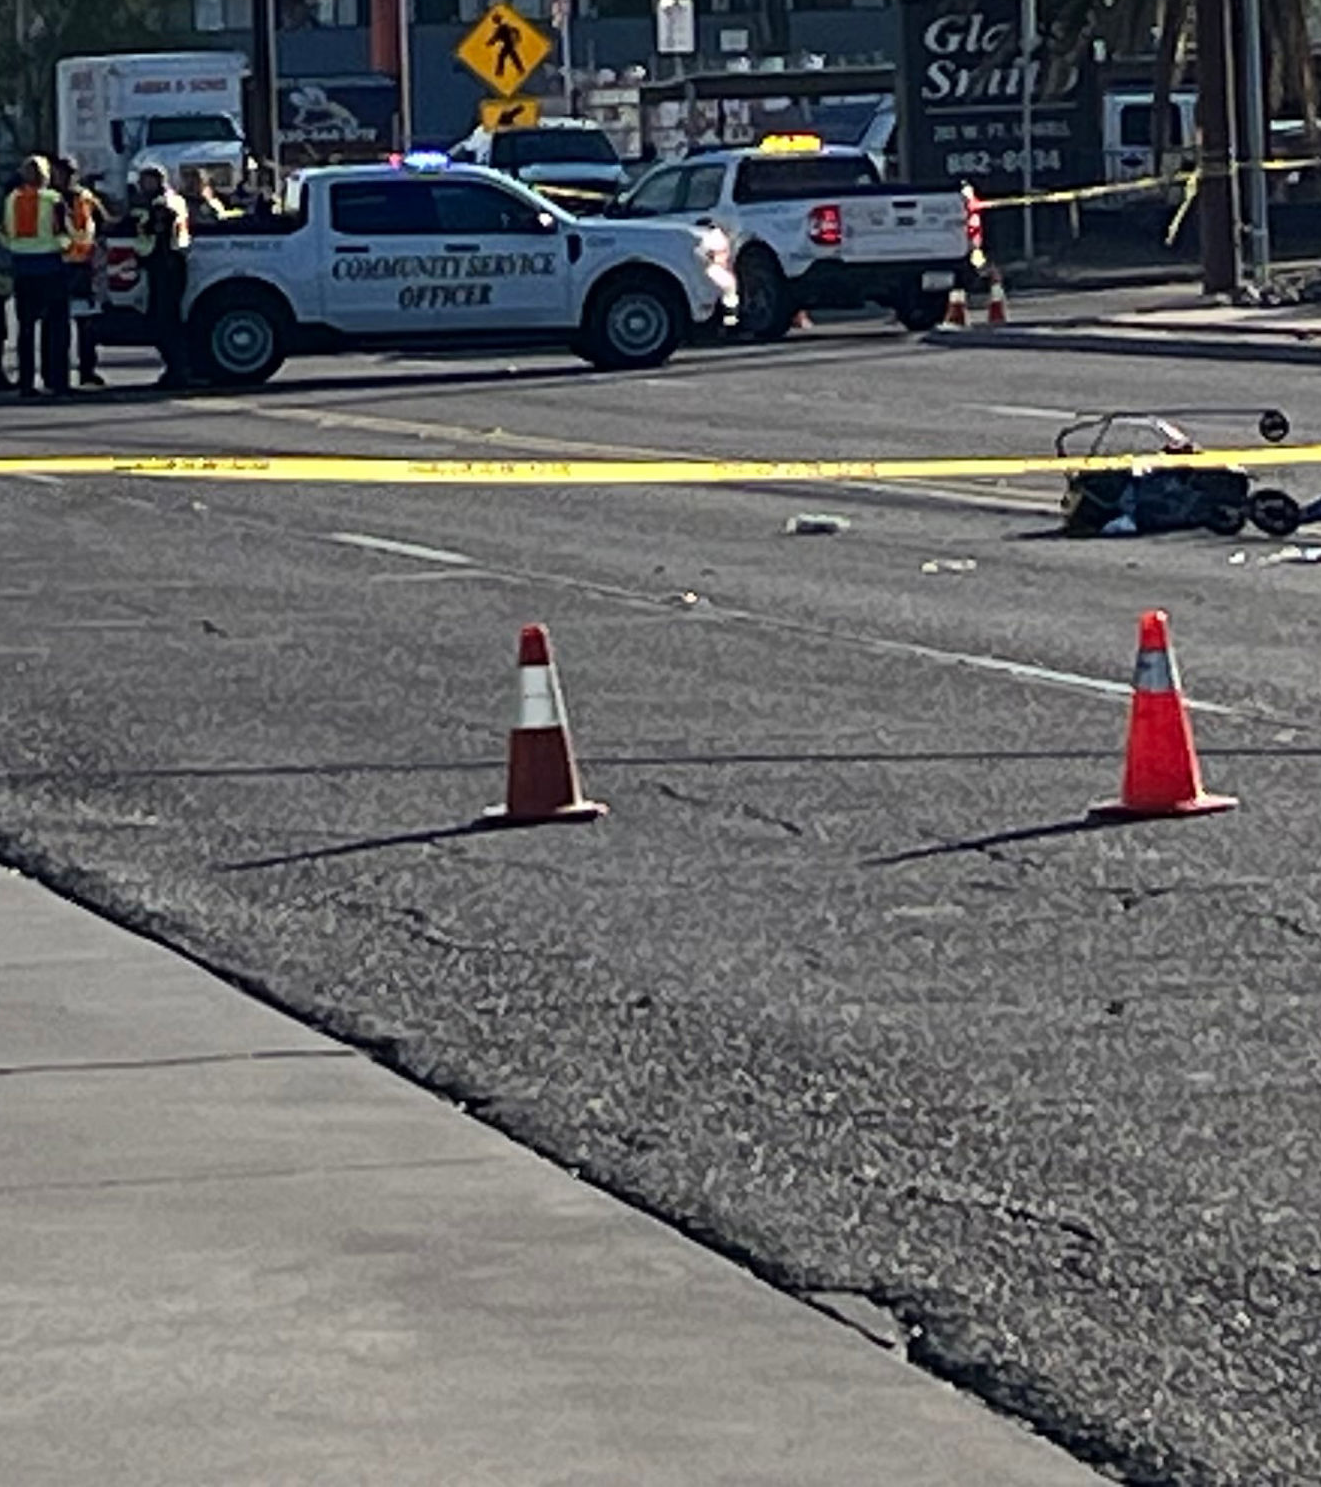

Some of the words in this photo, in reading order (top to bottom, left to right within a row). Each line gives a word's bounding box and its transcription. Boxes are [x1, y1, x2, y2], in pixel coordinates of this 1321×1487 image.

[332, 255, 463, 280] COMMUNITY
[465, 252, 557, 278] SERVICE
[398, 283, 492, 310] OFFICER
